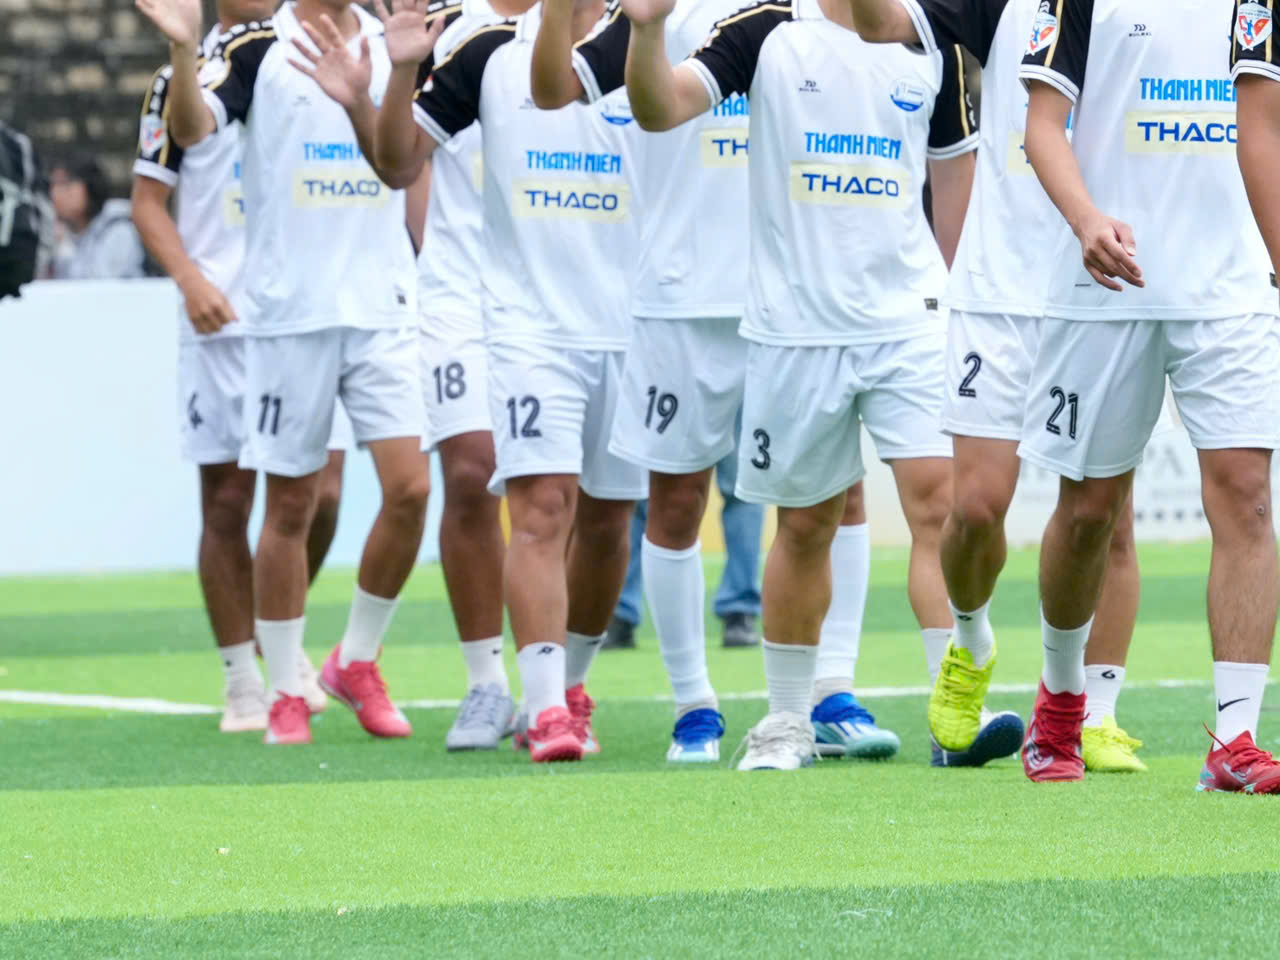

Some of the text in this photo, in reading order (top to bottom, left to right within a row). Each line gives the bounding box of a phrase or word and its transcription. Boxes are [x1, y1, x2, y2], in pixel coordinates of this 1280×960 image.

[1139, 78, 1202, 101] THANH
[526, 150, 581, 172] THANH
[804, 132, 864, 155] THANH
[303, 179, 381, 197] THACO
[524, 189, 618, 211] THACO
[802, 173, 899, 197] THACO
[433, 362, 466, 404] 18
[958, 351, 982, 398] 2
[258, 393, 282, 436] 11
[506, 395, 542, 439] 12
[644, 385, 678, 435] 19
[1046, 386, 1079, 440] 21
[751, 428, 770, 471] 3
